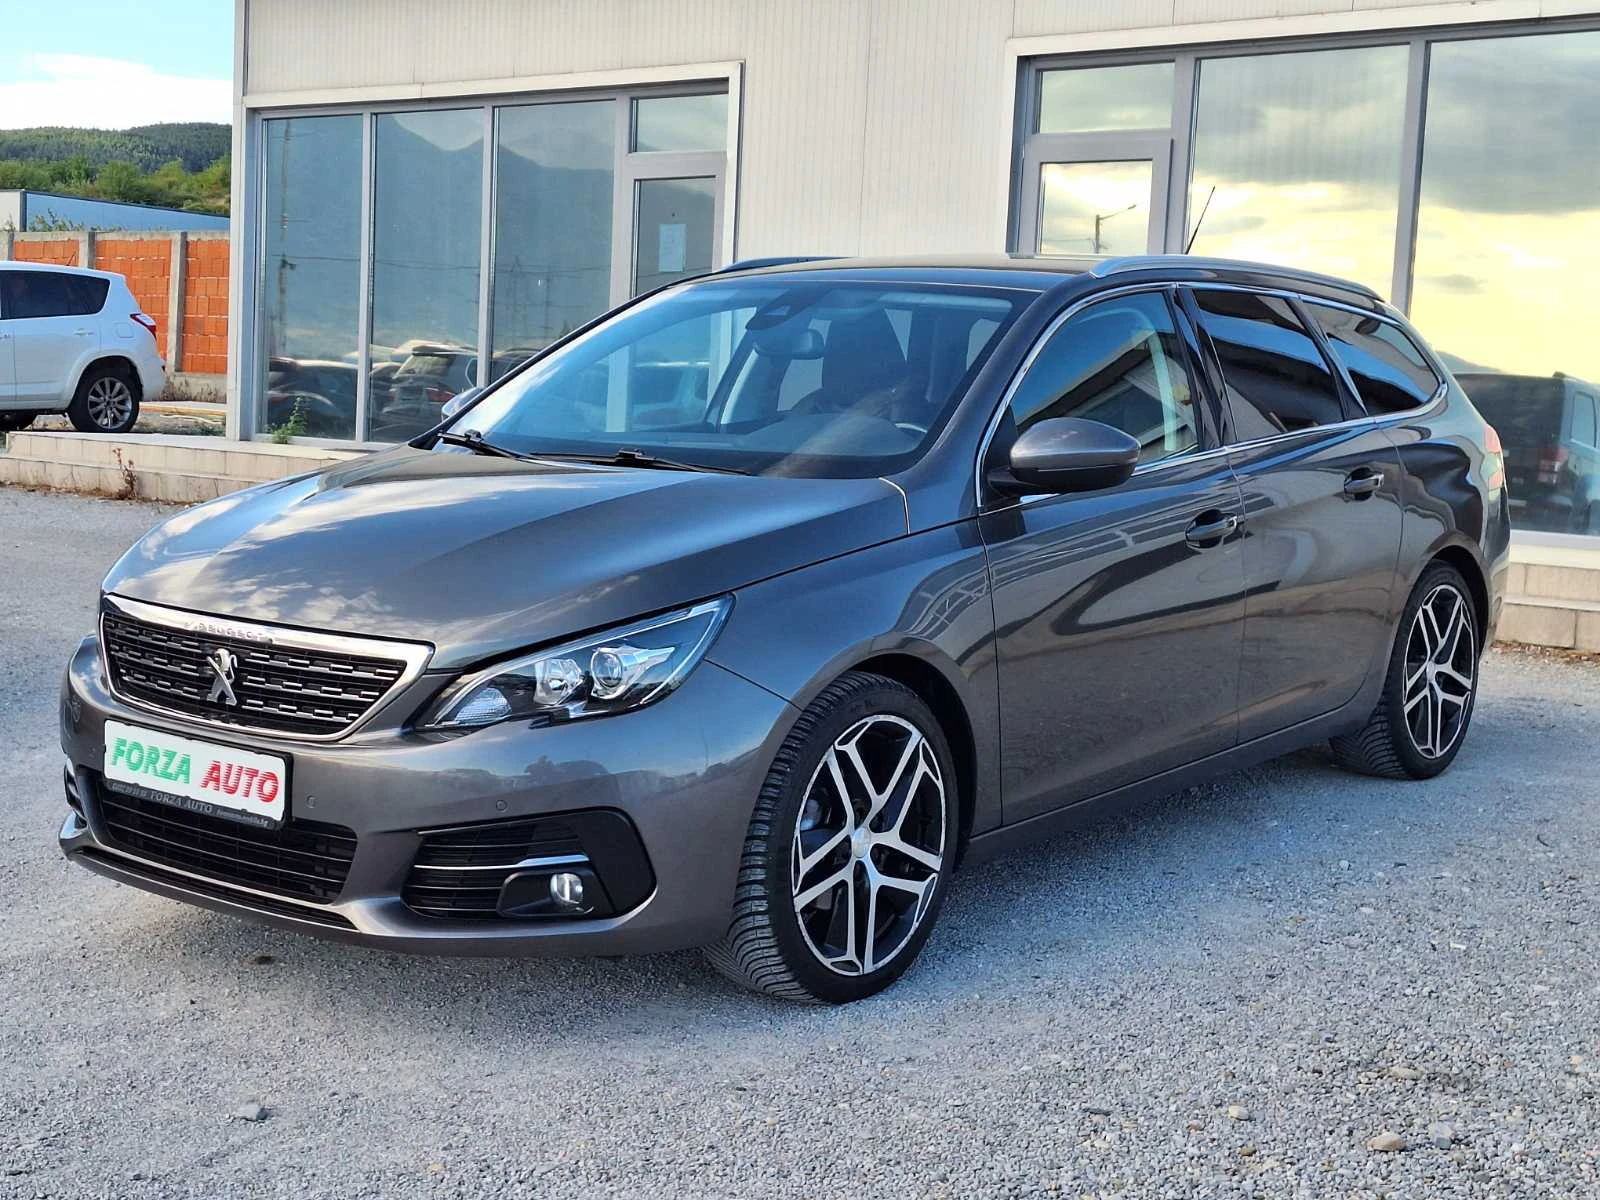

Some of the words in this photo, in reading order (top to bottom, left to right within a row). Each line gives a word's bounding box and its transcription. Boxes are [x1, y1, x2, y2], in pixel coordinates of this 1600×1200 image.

[112, 738, 191, 784] FORZA
[201, 760, 279, 803] AUTO
[150, 790, 182, 807] FORZA
[185, 800, 213, 814] AUTO
